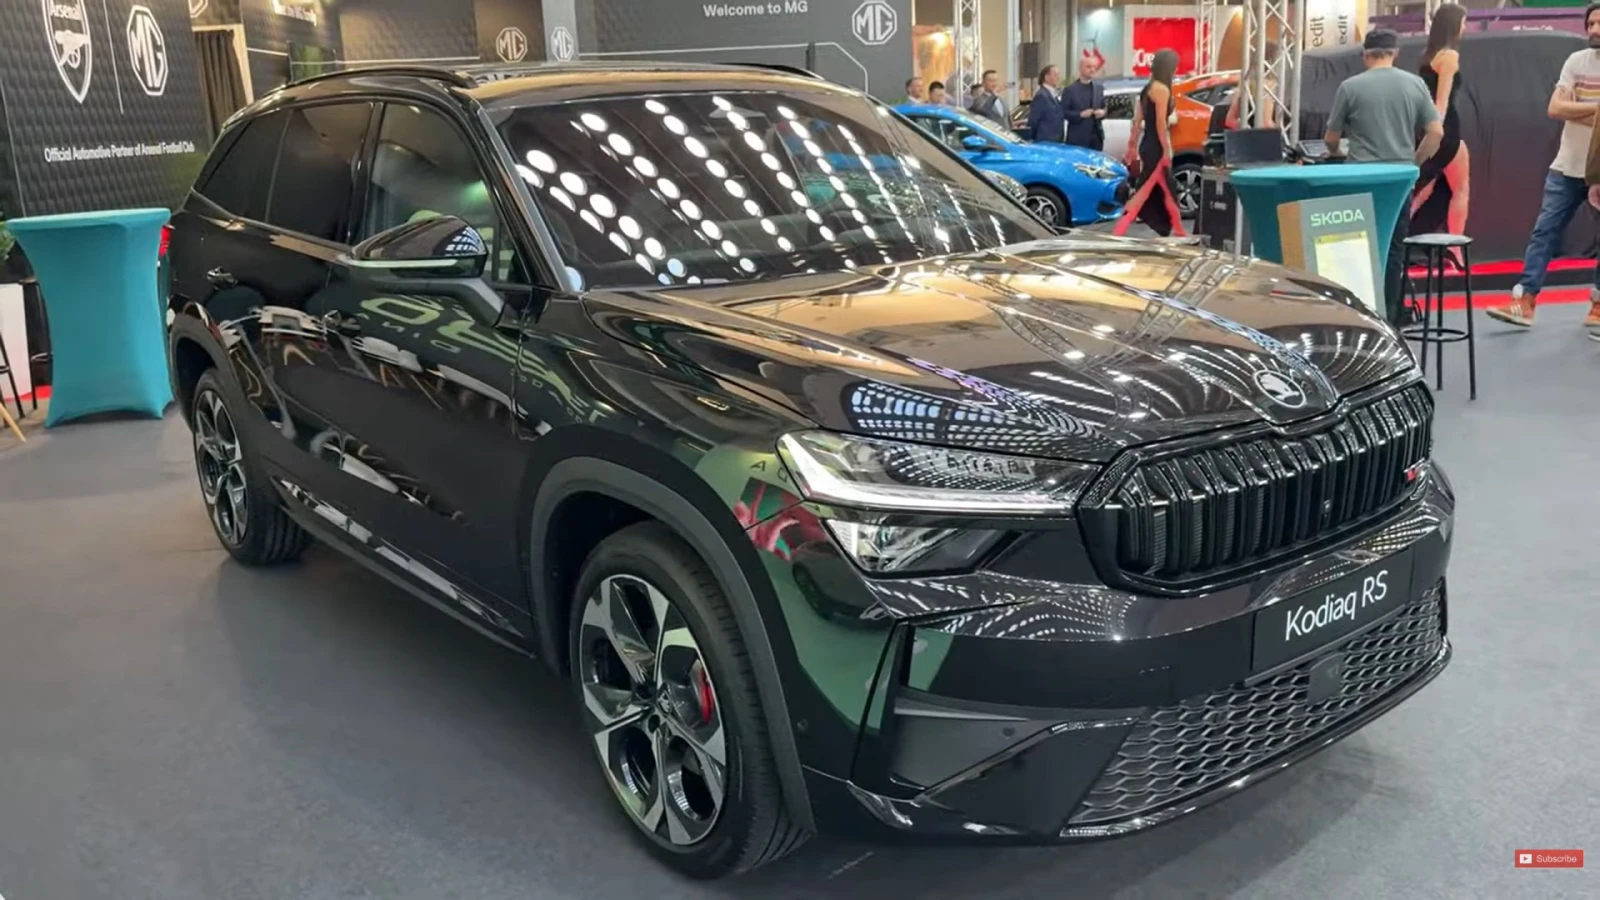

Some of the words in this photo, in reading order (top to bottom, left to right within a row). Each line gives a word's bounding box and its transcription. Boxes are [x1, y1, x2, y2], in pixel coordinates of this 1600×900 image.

[703, 4, 764, 17] Welcome
[767, 3, 781, 14] to
[785, 1, 808, 14] MG
[855, 4, 894, 42] MG
[131, 13, 164, 89] MG
[499, 30, 525, 61] MG
[551, 29, 573, 60] MG
[44, 147, 72, 162] Official
[73, 145, 111, 160] Automotive
[111, 143, 134, 158] Partner
[134, 143, 141, 156] of
[162, 141, 182, 154] Football
[182, 140, 195, 153] Club
[1285, 591, 1357, 641] Kodiaq
[1362, 569, 1388, 607] RS
